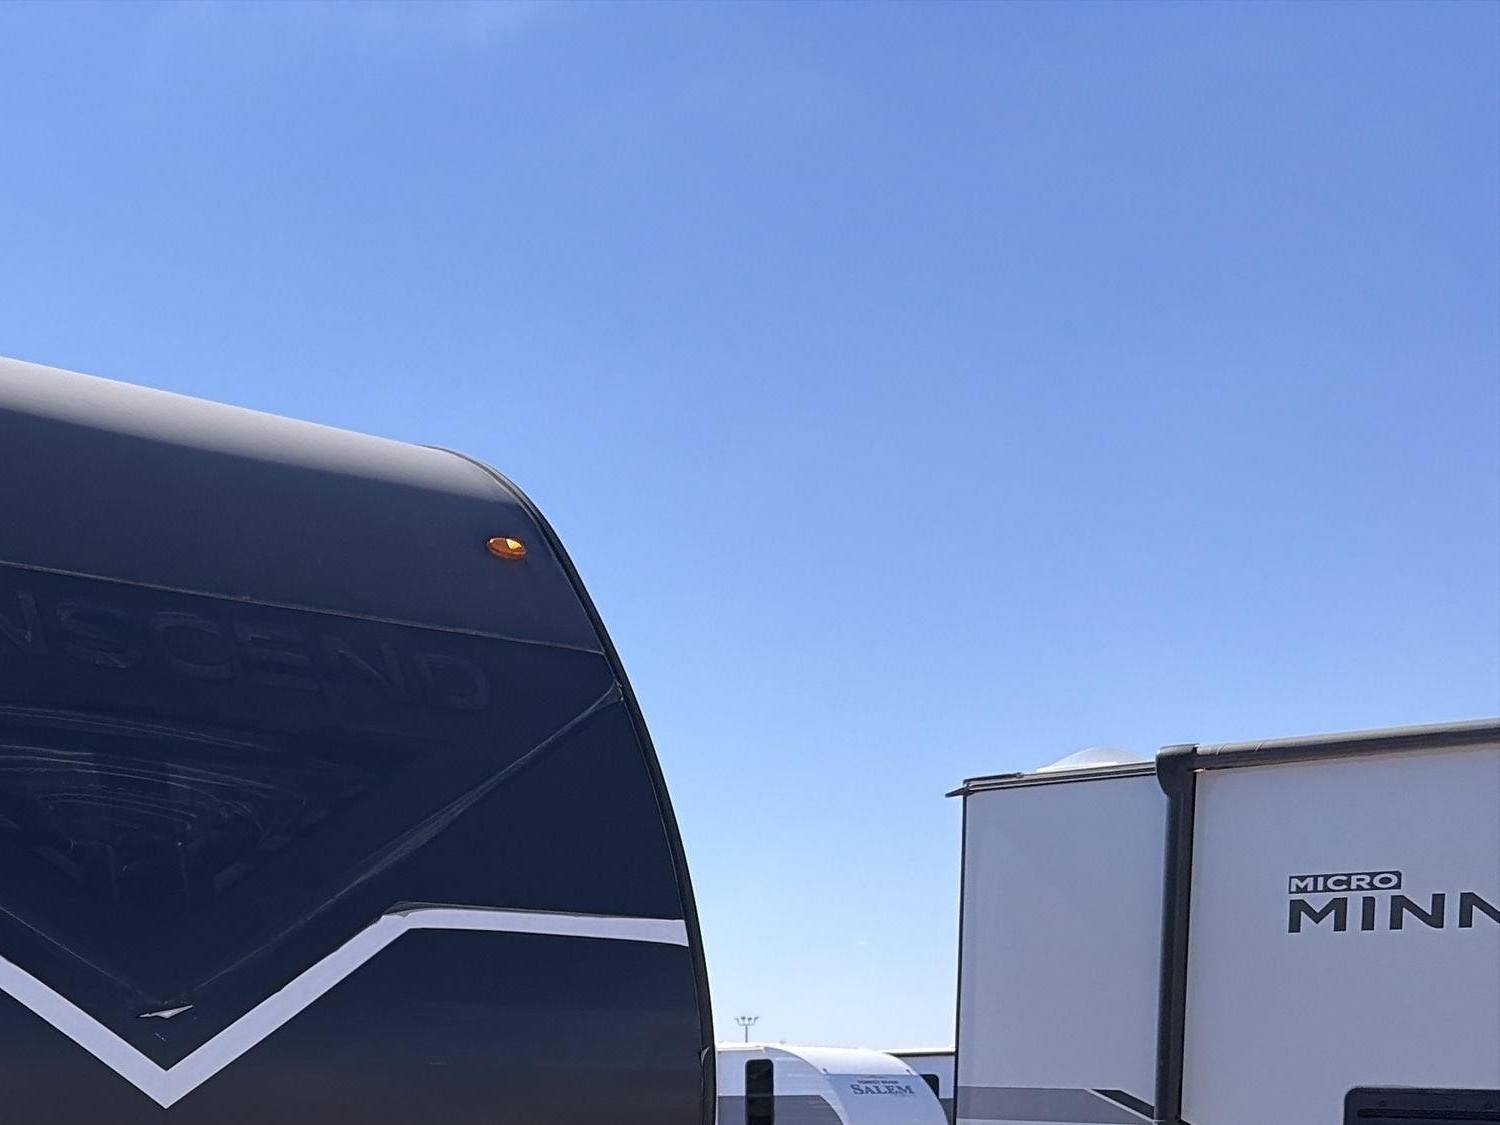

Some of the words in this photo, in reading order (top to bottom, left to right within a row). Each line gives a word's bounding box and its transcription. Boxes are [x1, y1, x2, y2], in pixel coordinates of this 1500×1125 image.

[1289, 873, 1399, 892] MICRO
[1288, 892, 1500, 934] MINN
[850, 1084, 915, 1096] SALEM
